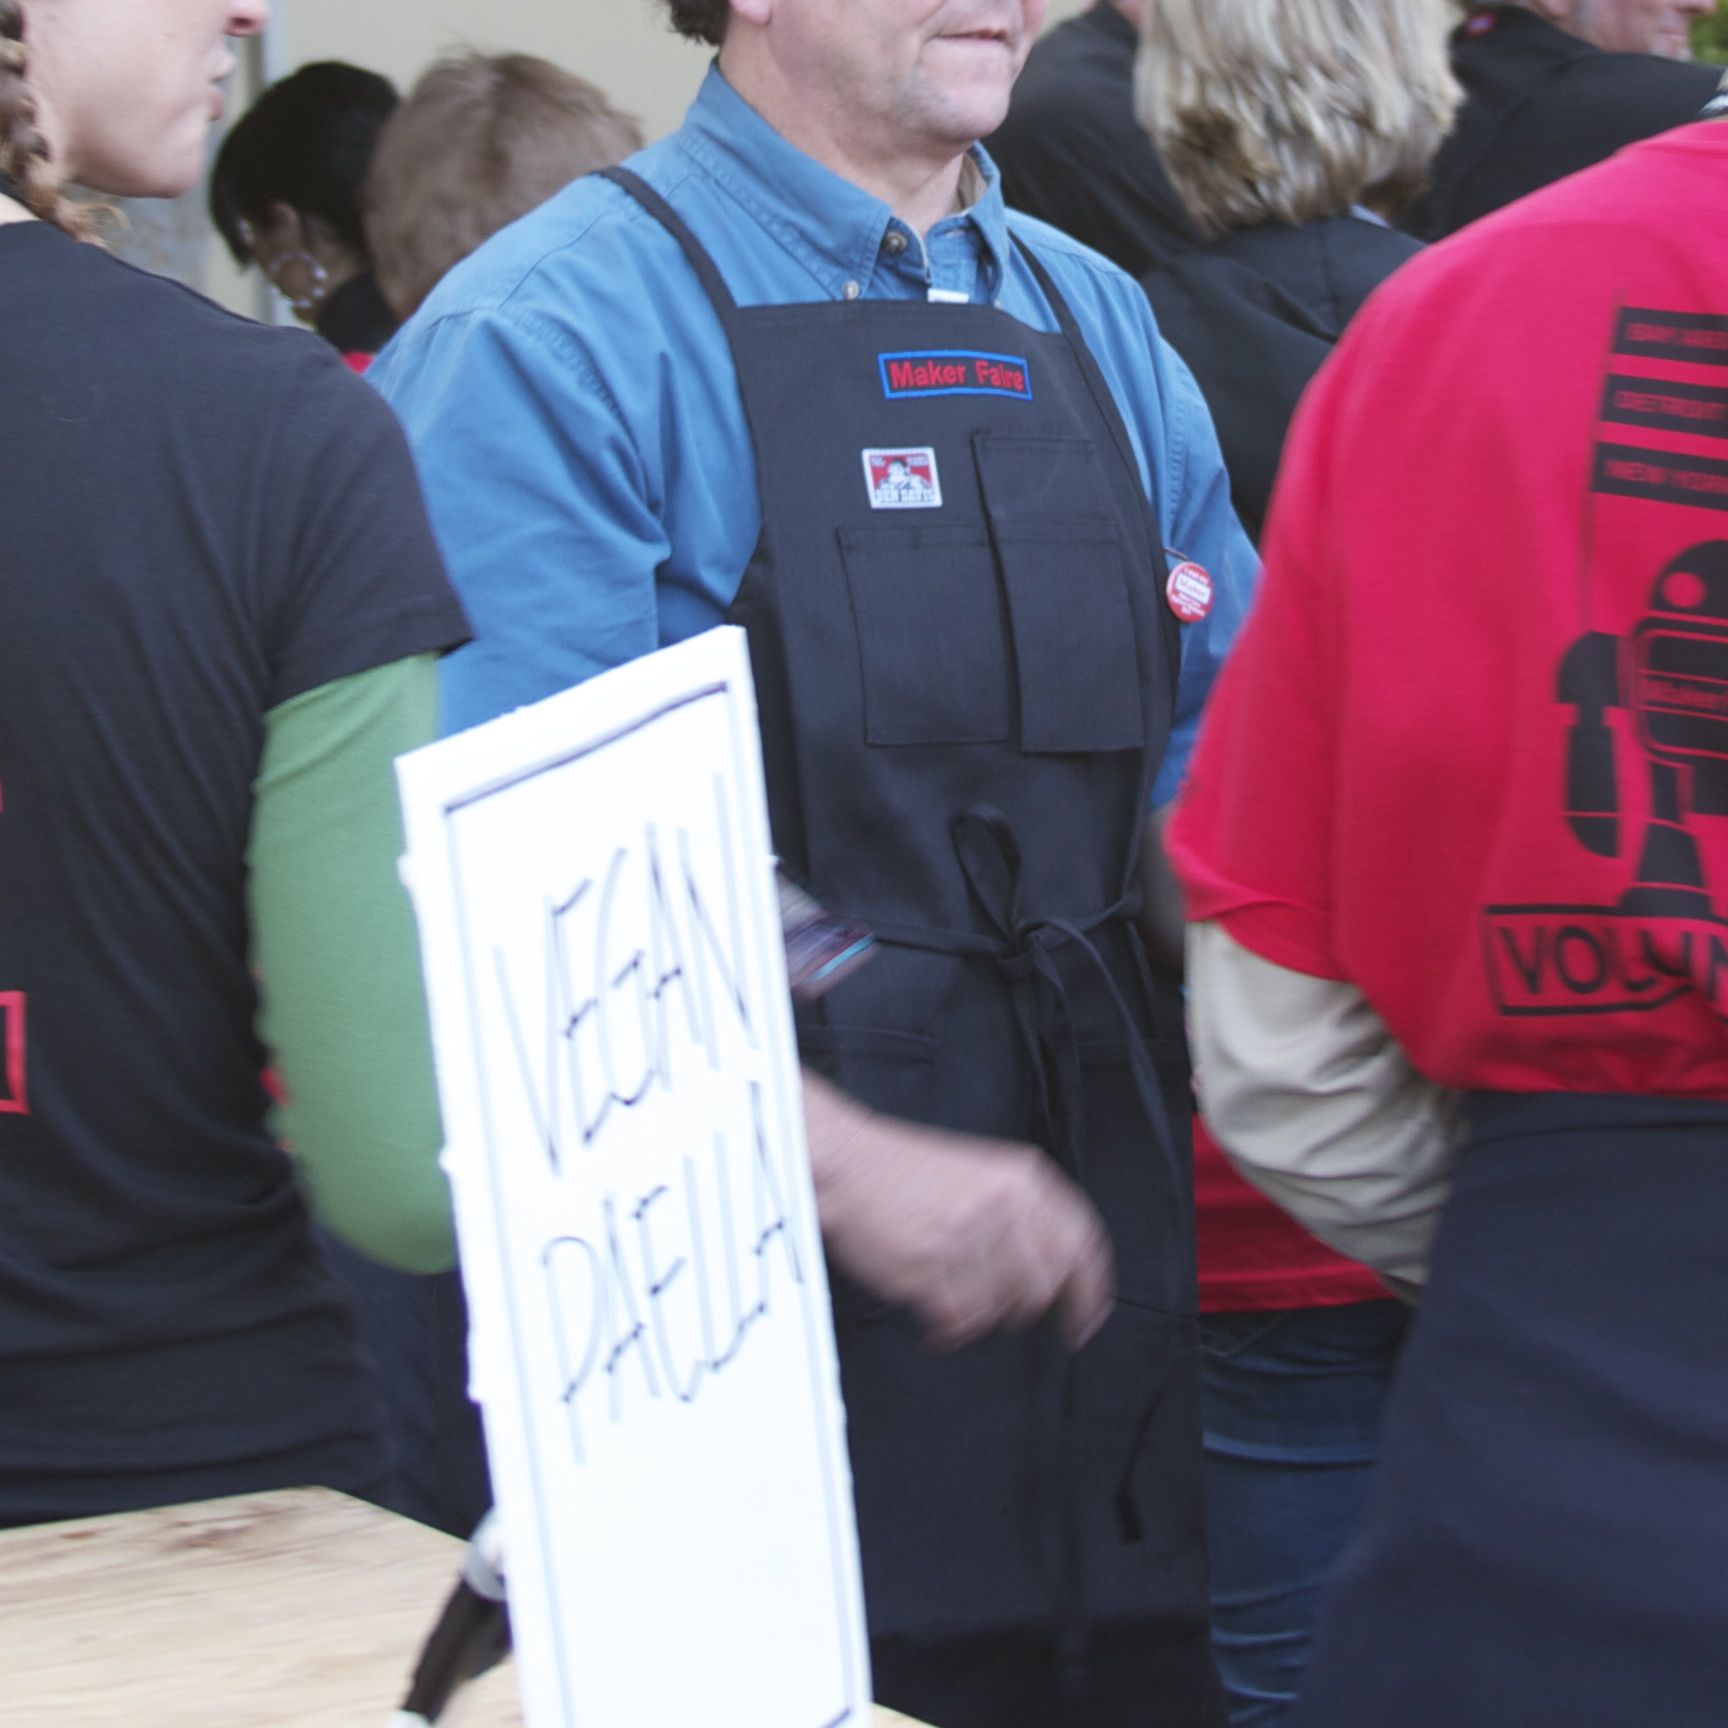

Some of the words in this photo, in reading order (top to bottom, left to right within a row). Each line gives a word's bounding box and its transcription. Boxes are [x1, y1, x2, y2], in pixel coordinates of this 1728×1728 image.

[889, 359, 966, 389] Maker
[975, 359, 1025, 391] Faire
[492, 770, 761, 1178] VEGAN
[541, 1078, 805, 1467] PAELLA
